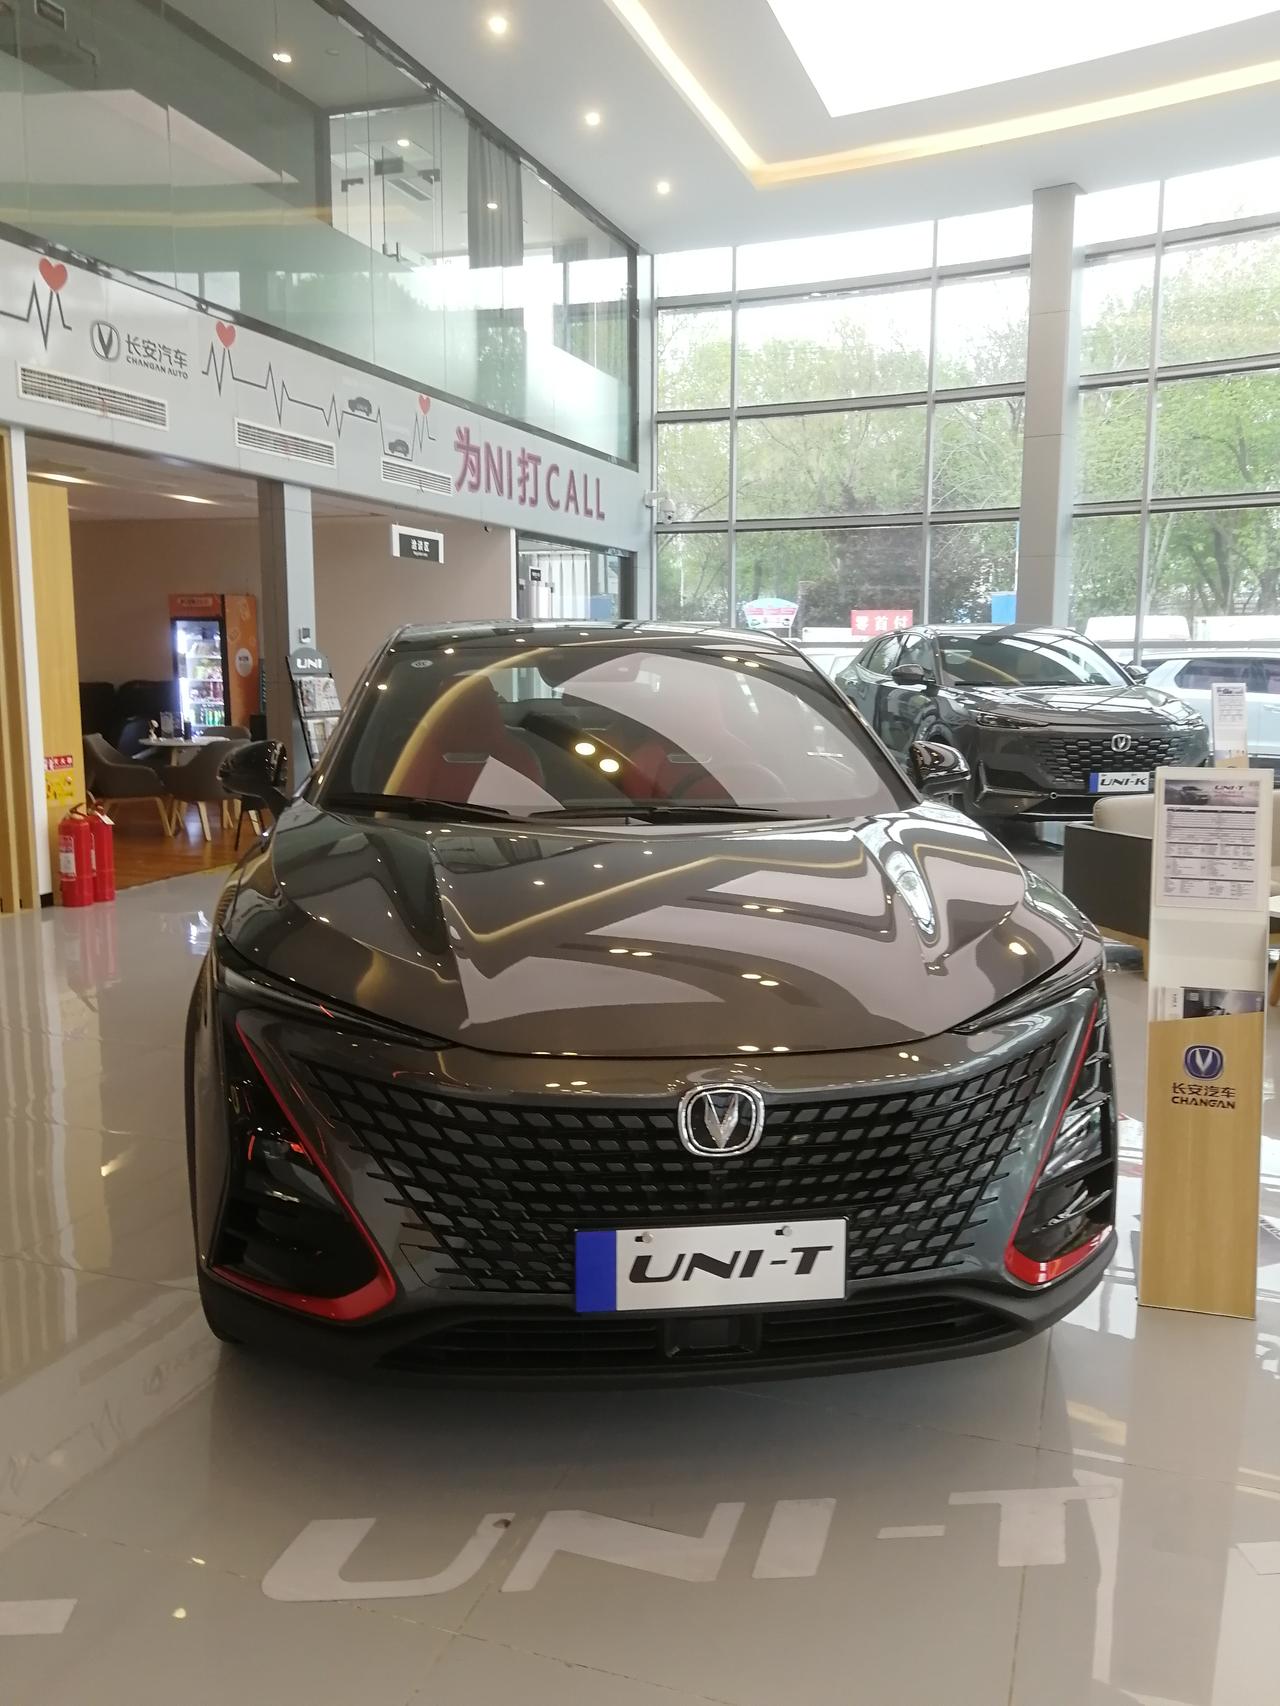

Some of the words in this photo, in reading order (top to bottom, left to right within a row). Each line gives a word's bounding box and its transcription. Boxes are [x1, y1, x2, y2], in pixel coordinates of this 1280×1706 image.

[125, 333, 187, 369] 长安汽车
[126, 356, 166, 373] CHANGAN
[167, 367, 188, 380] AUTO
[296, 658, 322, 669] UNI
[1100, 777, 1148, 786] UNI-K
[1171, 1082, 1236, 1098] 长安汽车
[1171, 1096, 1236, 1109] CHANGAN
[628, 1245, 834, 1284] UNI-T
